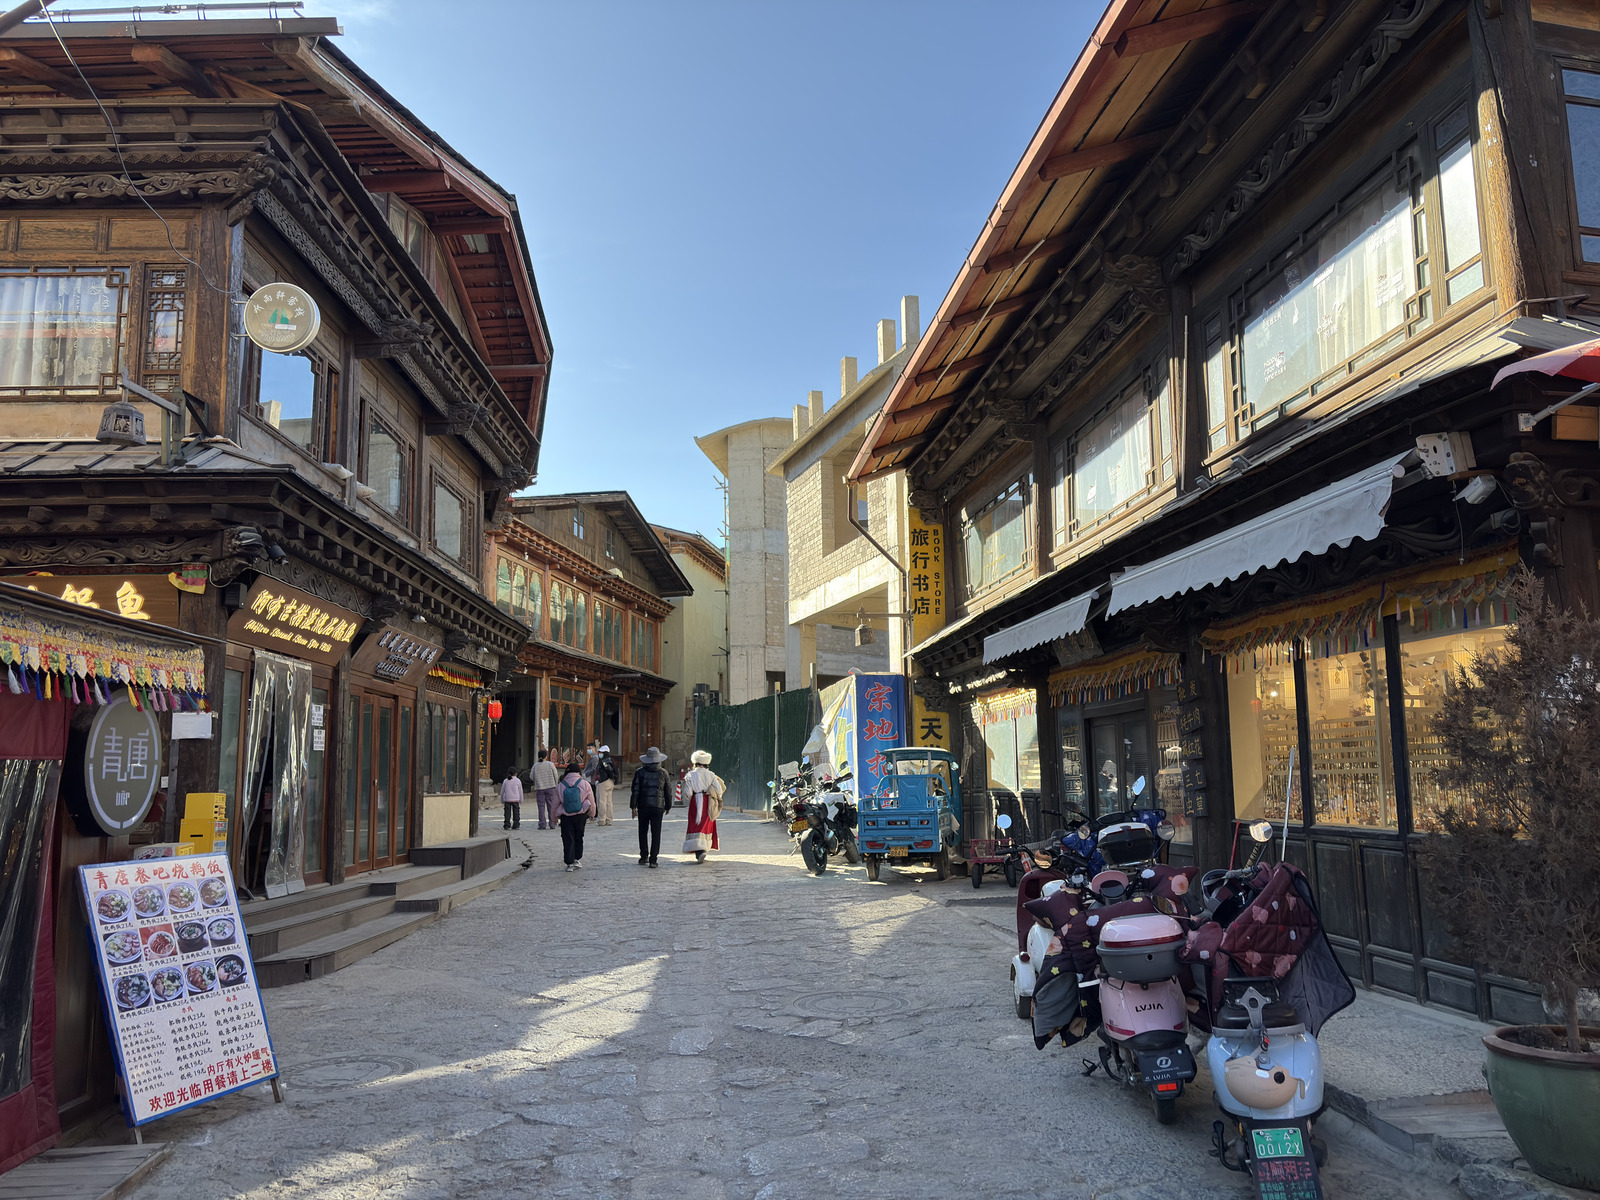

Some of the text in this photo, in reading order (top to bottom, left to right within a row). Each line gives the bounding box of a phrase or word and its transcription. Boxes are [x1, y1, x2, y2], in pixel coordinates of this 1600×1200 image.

[911, 528, 930, 615] 旅行书店
[933, 529, 942, 615] BOOK STORE
[27, 581, 151, 620] 锅鱼
[862, 682, 898, 808] 宗地
[920, 717, 943, 748] 天
[1181, 738, 1203, 759] 藏红花
[1185, 770, 1203, 788] 三七
[1186, 796, 1204, 815] 虫草
[91, 859, 224, 890] 青唐餐吧烧鹅饭
[205, 1046, 270, 1076] 内厅有火炉暖气
[147, 1057, 274, 1113] 欢迎光临用餐请上二楼
[1258, 1142, 1302, 1156] 0012X
[1264, 1132, 1291, 1141] 云 A
